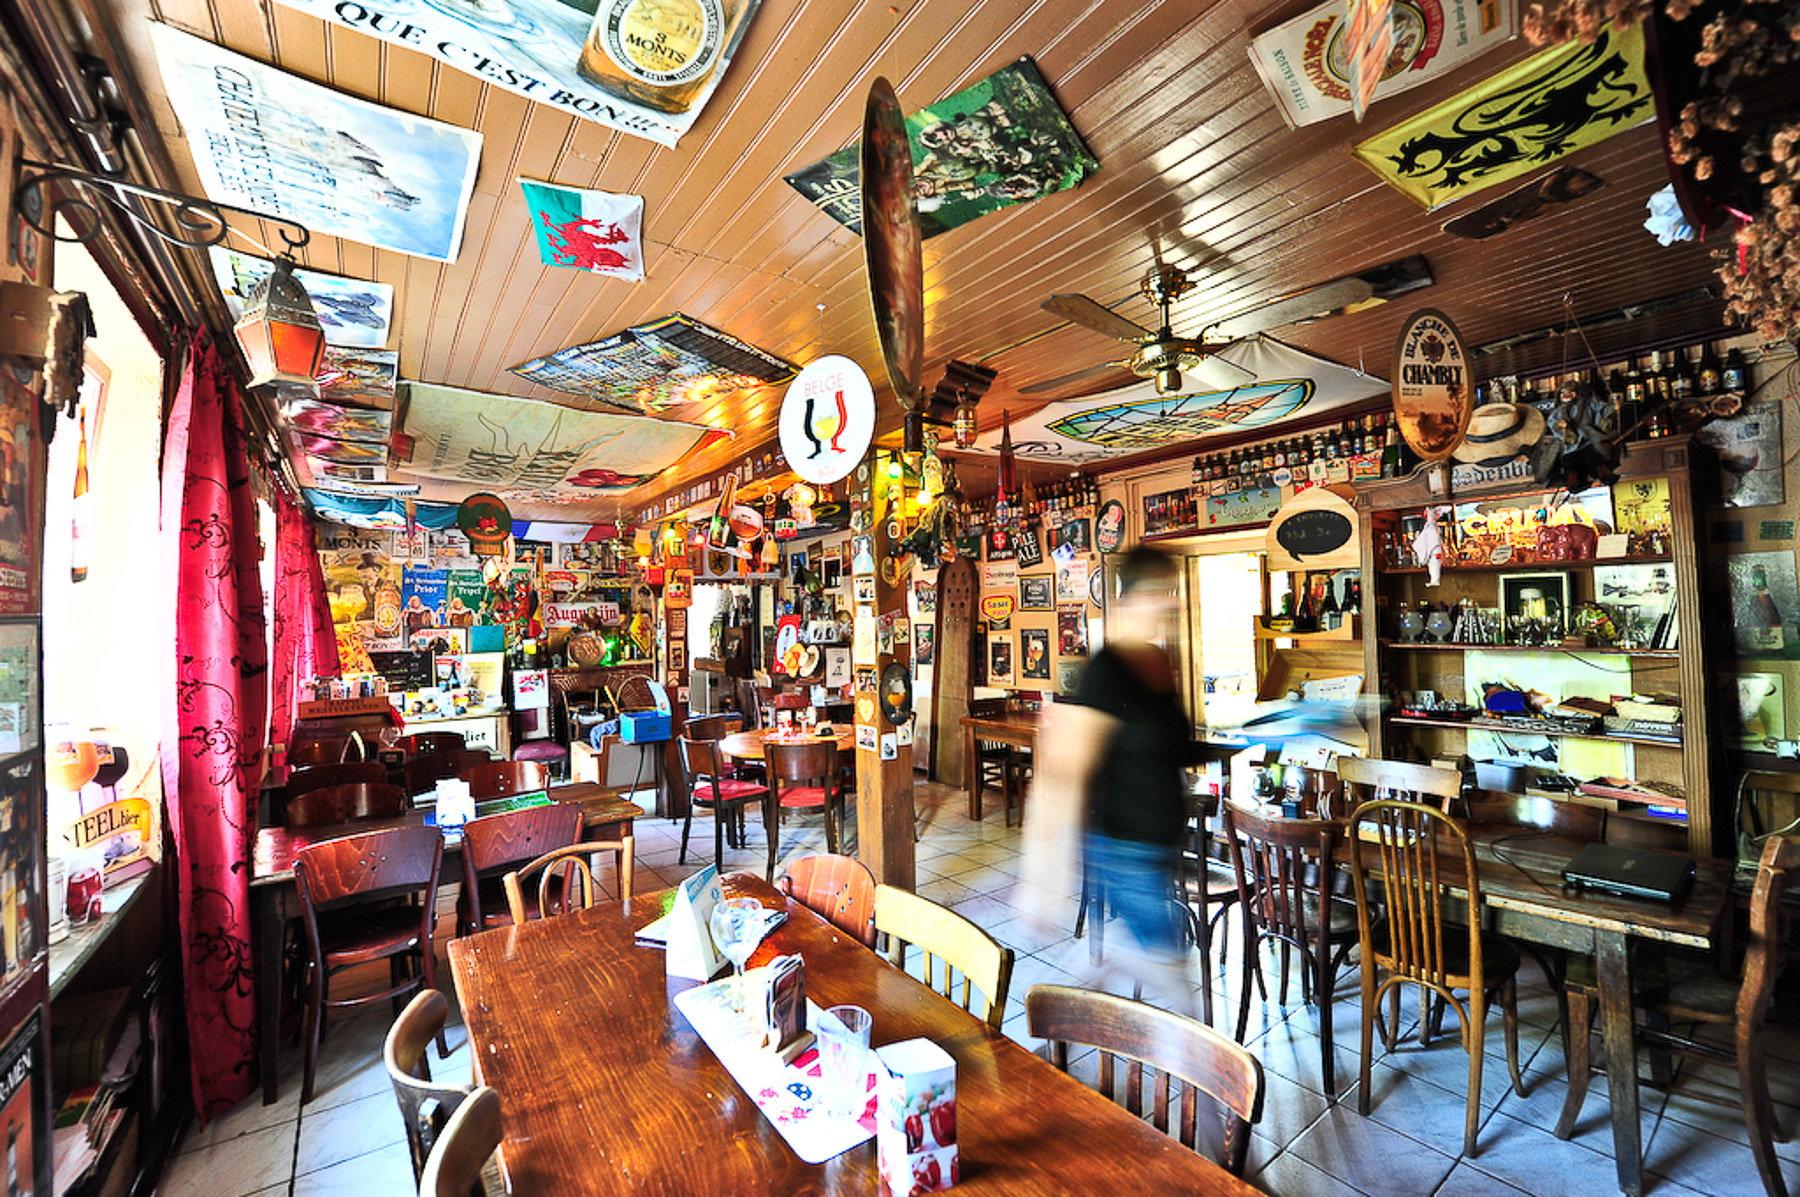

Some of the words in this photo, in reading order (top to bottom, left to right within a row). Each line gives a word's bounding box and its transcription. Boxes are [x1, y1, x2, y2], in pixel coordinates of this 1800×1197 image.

[334, 0, 427, 46] QUE
[437, 40, 548, 93] C'EST
[625, 32, 687, 65] MONTS
[655, 32, 667, 44] 3
[1404, 317, 1450, 359] BLANCHE
[1446, 339, 1461, 361] DE
[804, 372, 844, 398] BELGE
[1402, 363, 1463, 386] CHAMBLY
[324, 536, 384, 550] MONTS
[1017, 544, 1040, 562] ALE
[414, 585, 439, 594] Prior
[546, 604, 618, 625] Auguijn
